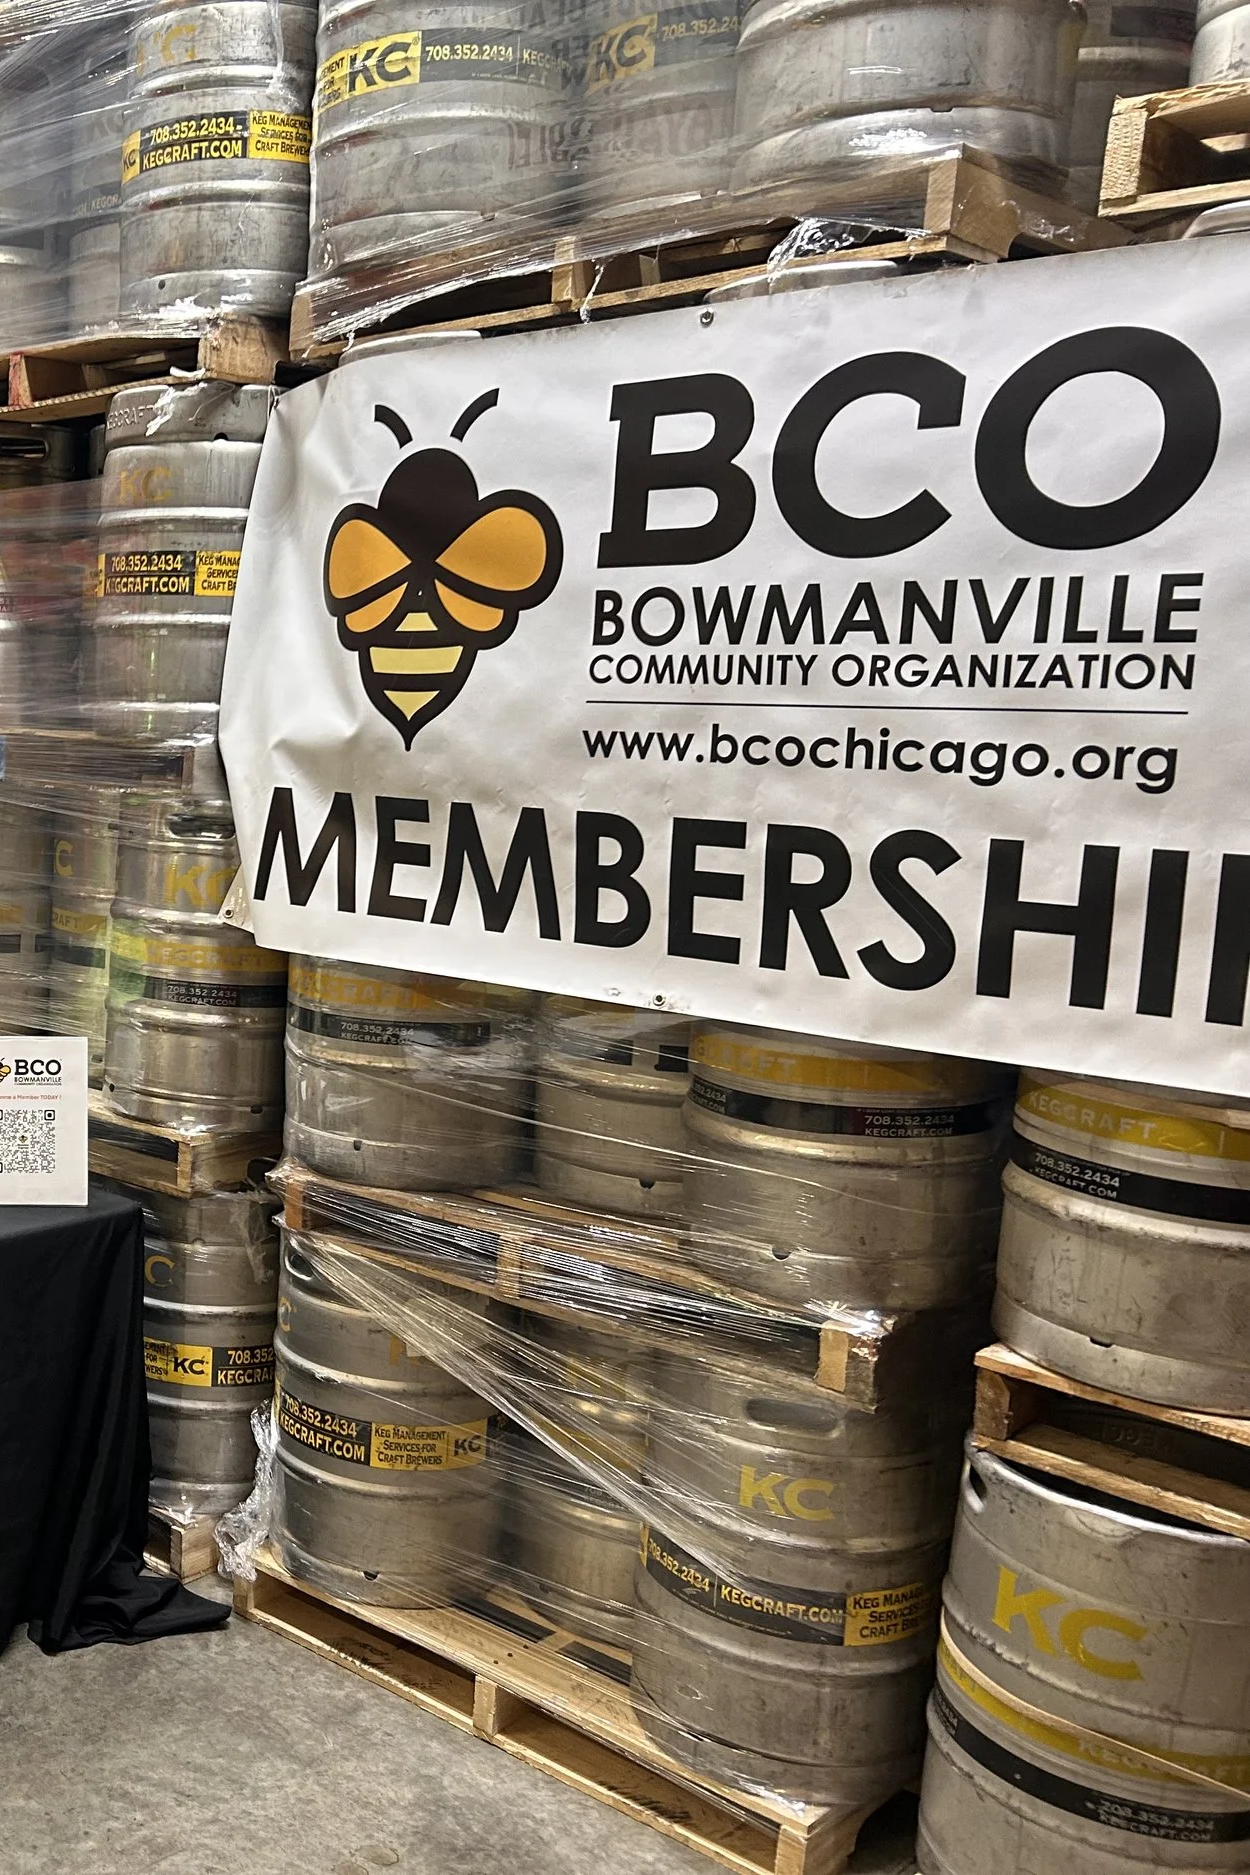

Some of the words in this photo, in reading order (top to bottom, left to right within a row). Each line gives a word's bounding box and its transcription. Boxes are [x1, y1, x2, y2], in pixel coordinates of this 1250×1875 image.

[425, 44, 513, 62] 708.352.2434
[589, 22, 652, 84] KC
[349, 40, 413, 93] KC
[252, 112, 268, 125] KEG
[269, 114, 310, 129] MANAGEMEN
[150, 117, 235, 144] 708.352.2434
[260, 127, 294, 141] SERVICES
[256, 139, 280, 152] CRAFT
[123, 151, 136, 173] KC
[142, 139, 243, 172] KEGCRAFT.COM
[598, 326, 1222, 569] BCO
[120, 466, 172, 505] KC
[111, 554, 182, 572] 708.352.2434
[199, 556, 214, 566] KEG
[201, 580, 226, 592] CRAFT
[592, 573, 1205, 648] BOWMANVILLE
[589, 653, 816, 688] COMMUNITY
[831, 652, 1196, 691] ORGANIZATION
[583, 722, 1180, 795] www.bcochicago.org
[53, 912, 79, 929] RAFT
[167, 985, 238, 998] 708.352.2434
[341, 1022, 415, 1037] 708.352.2434
[14, 1059, 62, 1076] BCO
[864, 1114, 955, 1126] 708.352.2434
[1029, 1091, 1158, 1140] KEGCRAFT
[864, 1127, 953, 1138] KEGCRAFT.COM
[1034, 1152, 1121, 1188] 708.352.2434
[1034, 1166, 1118, 1199] KEGCRAFT.COM
[146, 1355, 158, 1364] FOR
[173, 1357, 206, 1375] KC
[144, 1365, 164, 1375] WERS
[285, 1394, 358, 1438] 708.352.2434
[279, 1412, 365, 1463] KEGCRAFT.COM
[374, 1425, 391, 1438] KEG
[392, 1427, 446, 1441] MANAGEMENT
[383, 1440, 419, 1453] SERVICES
[421, 1443, 437, 1453] FOR
[454, 1434, 482, 1457] KC
[377, 1451, 405, 1464] CRAFT
[406, 1452, 443, 1465] BREWERS
[737, 1465, 835, 1522] KC
[649, 1537, 710, 1593] 708.352.2434
[720, 1584, 844, 1624] KEGCRAFT.COM
[852, 1596, 880, 1610] KEG
[859, 1622, 898, 1639] CRAFT
[992, 1565, 1148, 1682] KC
